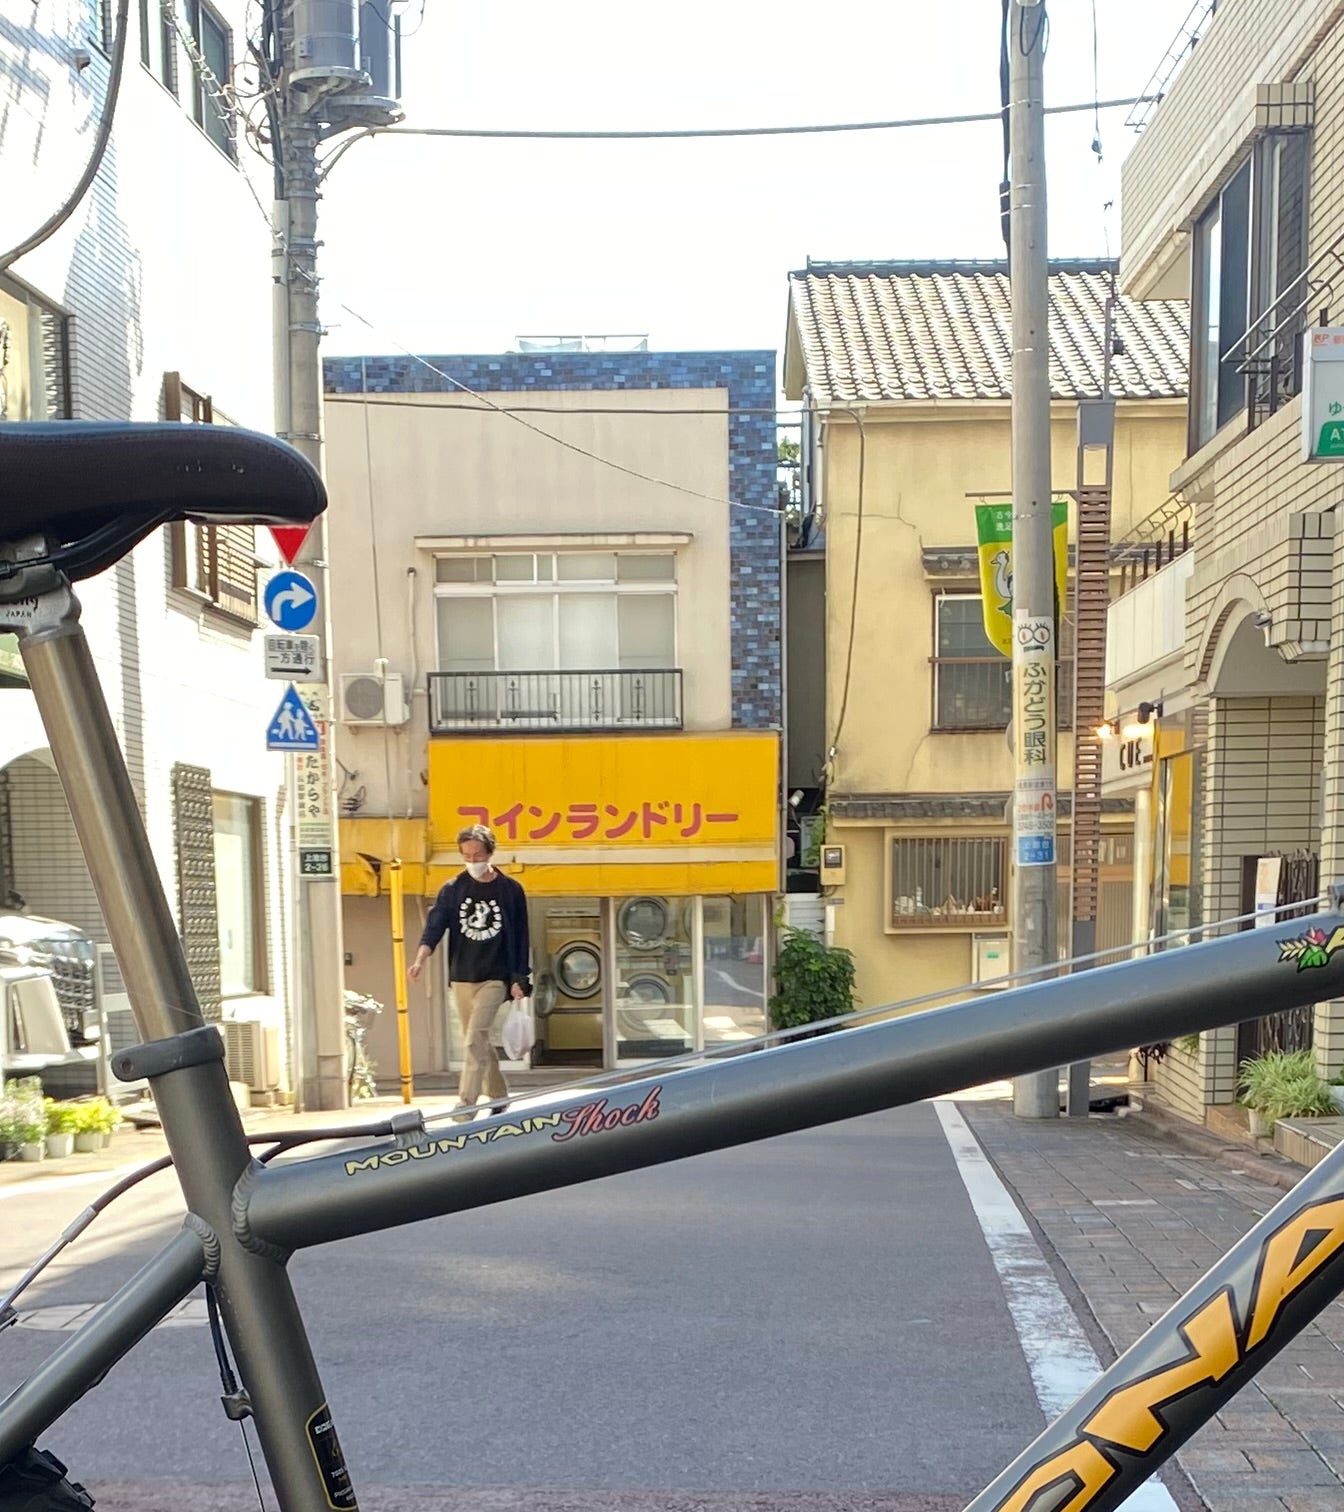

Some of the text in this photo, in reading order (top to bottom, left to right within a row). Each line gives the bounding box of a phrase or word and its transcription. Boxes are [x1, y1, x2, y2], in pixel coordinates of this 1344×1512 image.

[268, 652, 315, 665] 一方通行
[1023, 662, 1047, 765] ふかどう眼科
[1120, 738, 1142, 771] CUE
[306, 755, 321, 818] たからや
[457, 800, 739, 840] コインランドリー
[345, 1086, 662, 1177] MOUNTAIN Shock
